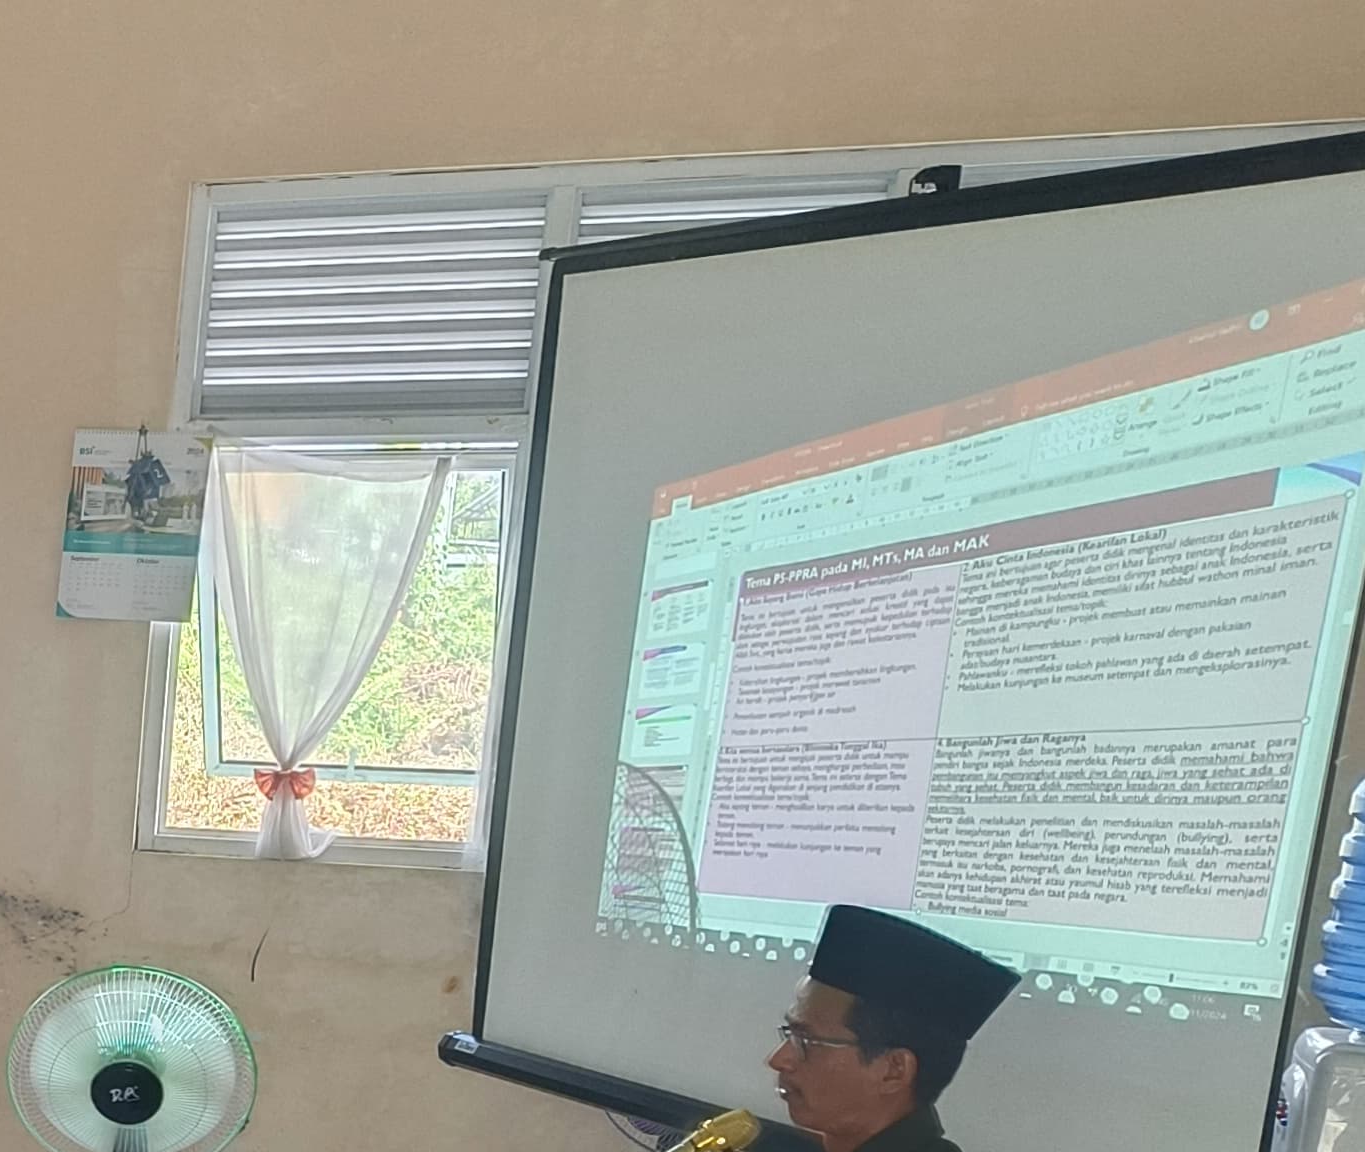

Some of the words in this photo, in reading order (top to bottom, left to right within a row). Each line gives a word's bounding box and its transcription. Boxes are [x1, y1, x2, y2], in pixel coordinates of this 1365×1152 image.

[1228, 528, 1249, 539] dan
[1252, 510, 1340, 535] karakteristik
[1228, 534, 1287, 552] Indonesia
[1296, 542, 1332, 555] serta
[820, 562, 849, 580] pada
[851, 556, 871, 572] MI,
[872, 550, 902, 567] MTs,
[903, 546, 925, 561] MA
[927, 544, 950, 558] dan
[952, 534, 990, 553] MAK
[1174, 596, 1236, 612] memainkan
[1239, 590, 1287, 604] mainan
[1210, 740, 1256, 750] amanat
[1266, 738, 1297, 749] para
[1178, 819, 1281, 830] masalah-masalah
[1244, 835, 1278, 843] serta
[1173, 845, 1276, 857] masalah-masalah
[1195, 858, 1216, 868] dan
